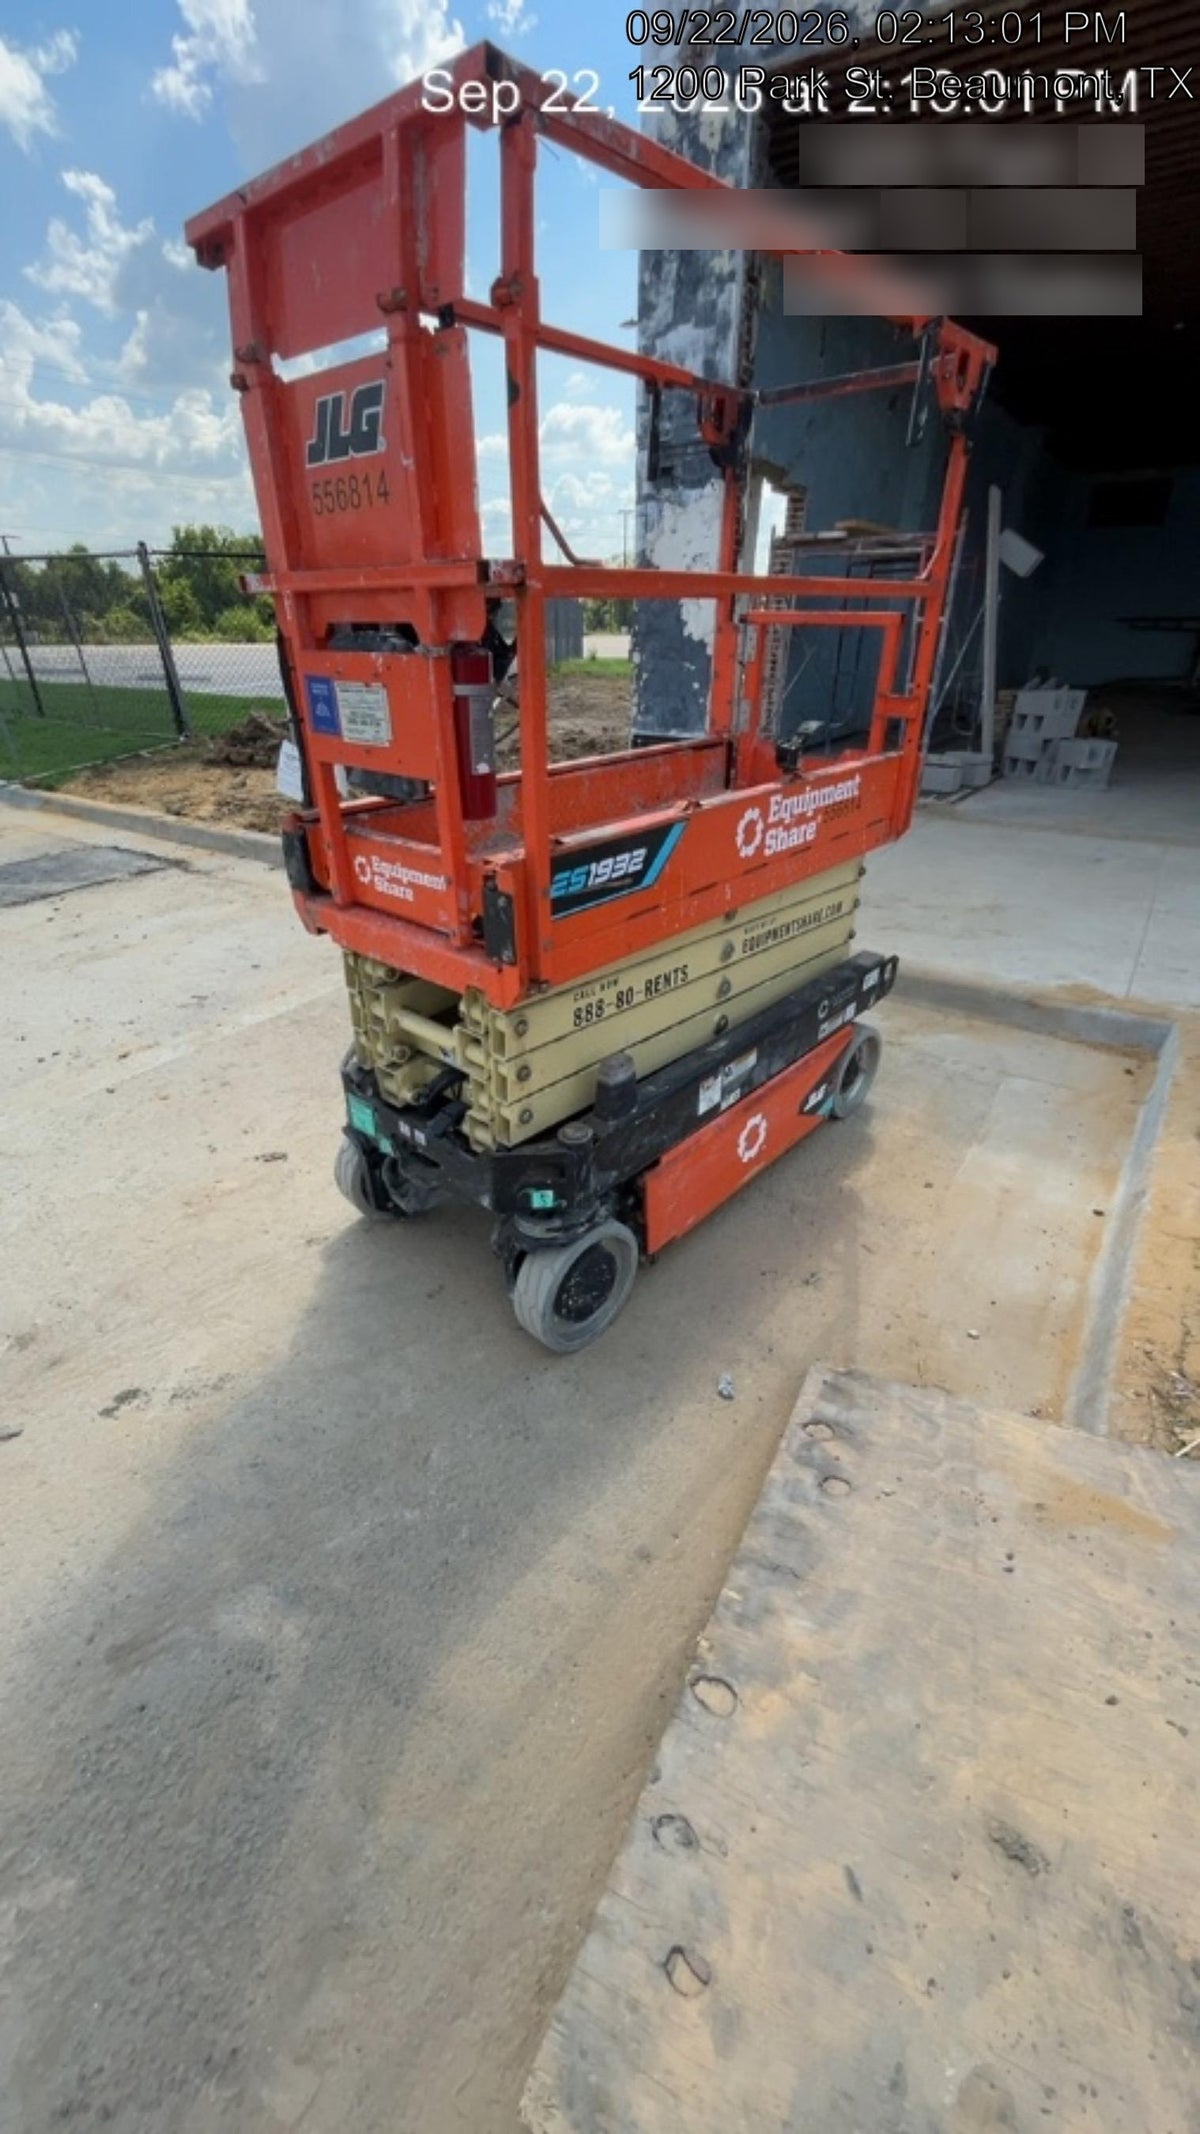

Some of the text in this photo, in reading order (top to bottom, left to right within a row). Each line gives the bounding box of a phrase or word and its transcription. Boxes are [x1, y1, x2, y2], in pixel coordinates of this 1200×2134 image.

[306, 380, 386, 469] JLG
[312, 470, 390, 516] 556814
[769, 774, 861, 824] Equipment
[764, 822, 817, 857] Share
[371, 855, 448, 891] Equipment
[374, 874, 414, 902] Share
[550, 847, 648, 899] ES1932
[573, 964, 689, 1028] 888-80-RENTS
